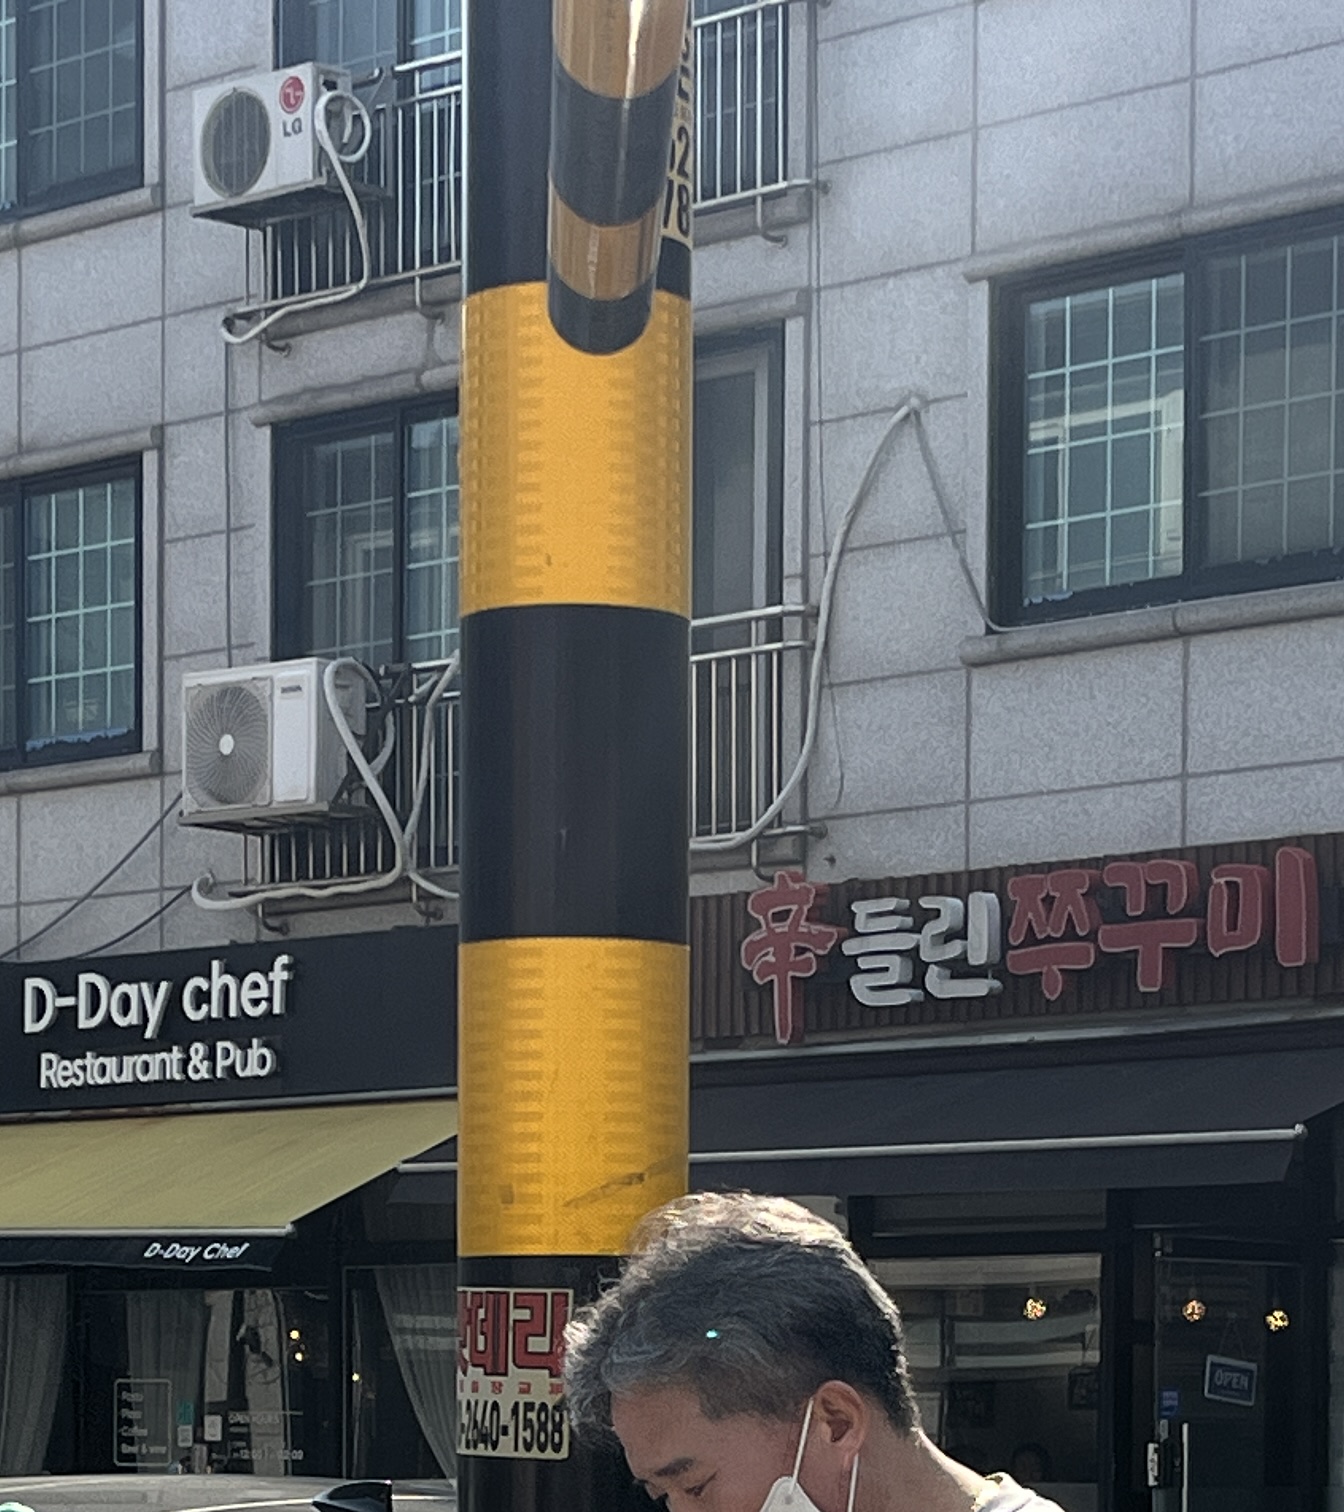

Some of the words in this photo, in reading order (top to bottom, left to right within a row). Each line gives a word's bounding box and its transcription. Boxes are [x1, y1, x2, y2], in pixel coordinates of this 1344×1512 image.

[282, 117, 303, 137] LG
[23, 971, 172, 1040] D-Day
[181, 954, 293, 1022] chef
[39, 1043, 186, 1090] Restaurant
[187, 1041, 211, 1082] &
[214, 1037, 276, 1080] Pub
[143, 1242, 202, 1263] D-Day
[1214, 1368, 1250, 1391] OPEN
